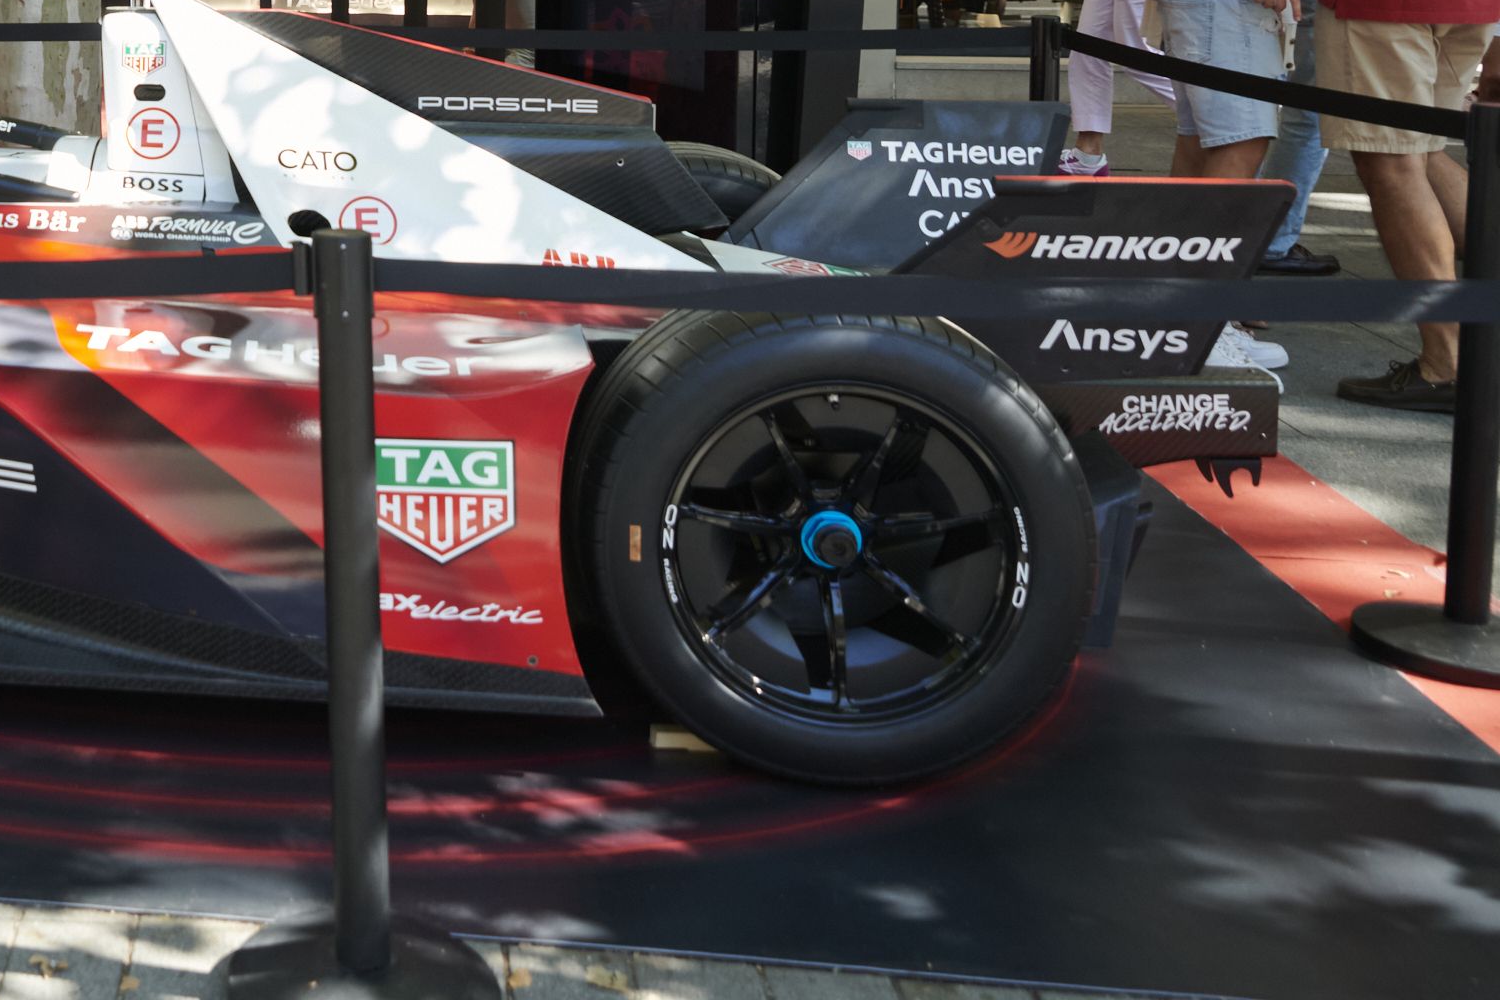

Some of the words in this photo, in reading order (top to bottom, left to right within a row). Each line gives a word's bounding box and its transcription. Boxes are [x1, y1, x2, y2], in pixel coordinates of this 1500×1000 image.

[124, 56, 164, 75] HEUER
[417, 96, 599, 114] PORSCHE
[278, 149, 358, 172] CATO
[122, 177, 184, 193] BOSS
[26, 208, 87, 234] Bär
[111, 215, 149, 230] ABB
[149, 216, 236, 236] FORMULA
[134, 231, 165, 239] WORLD
[166, 233, 231, 243] CHAMPIONSHIP
[1039, 319, 1189, 360] Ansys
[1122, 394, 1235, 414] CHANGE.
[1099, 409, 1251, 435] ACCELERATED.
[380, 448, 500, 487] TAG
[379, 494, 504, 552] HEUER
[1013, 506, 1029, 553] RACING
[663, 558, 679, 604] RACING
[410, 600, 544, 625] electric
